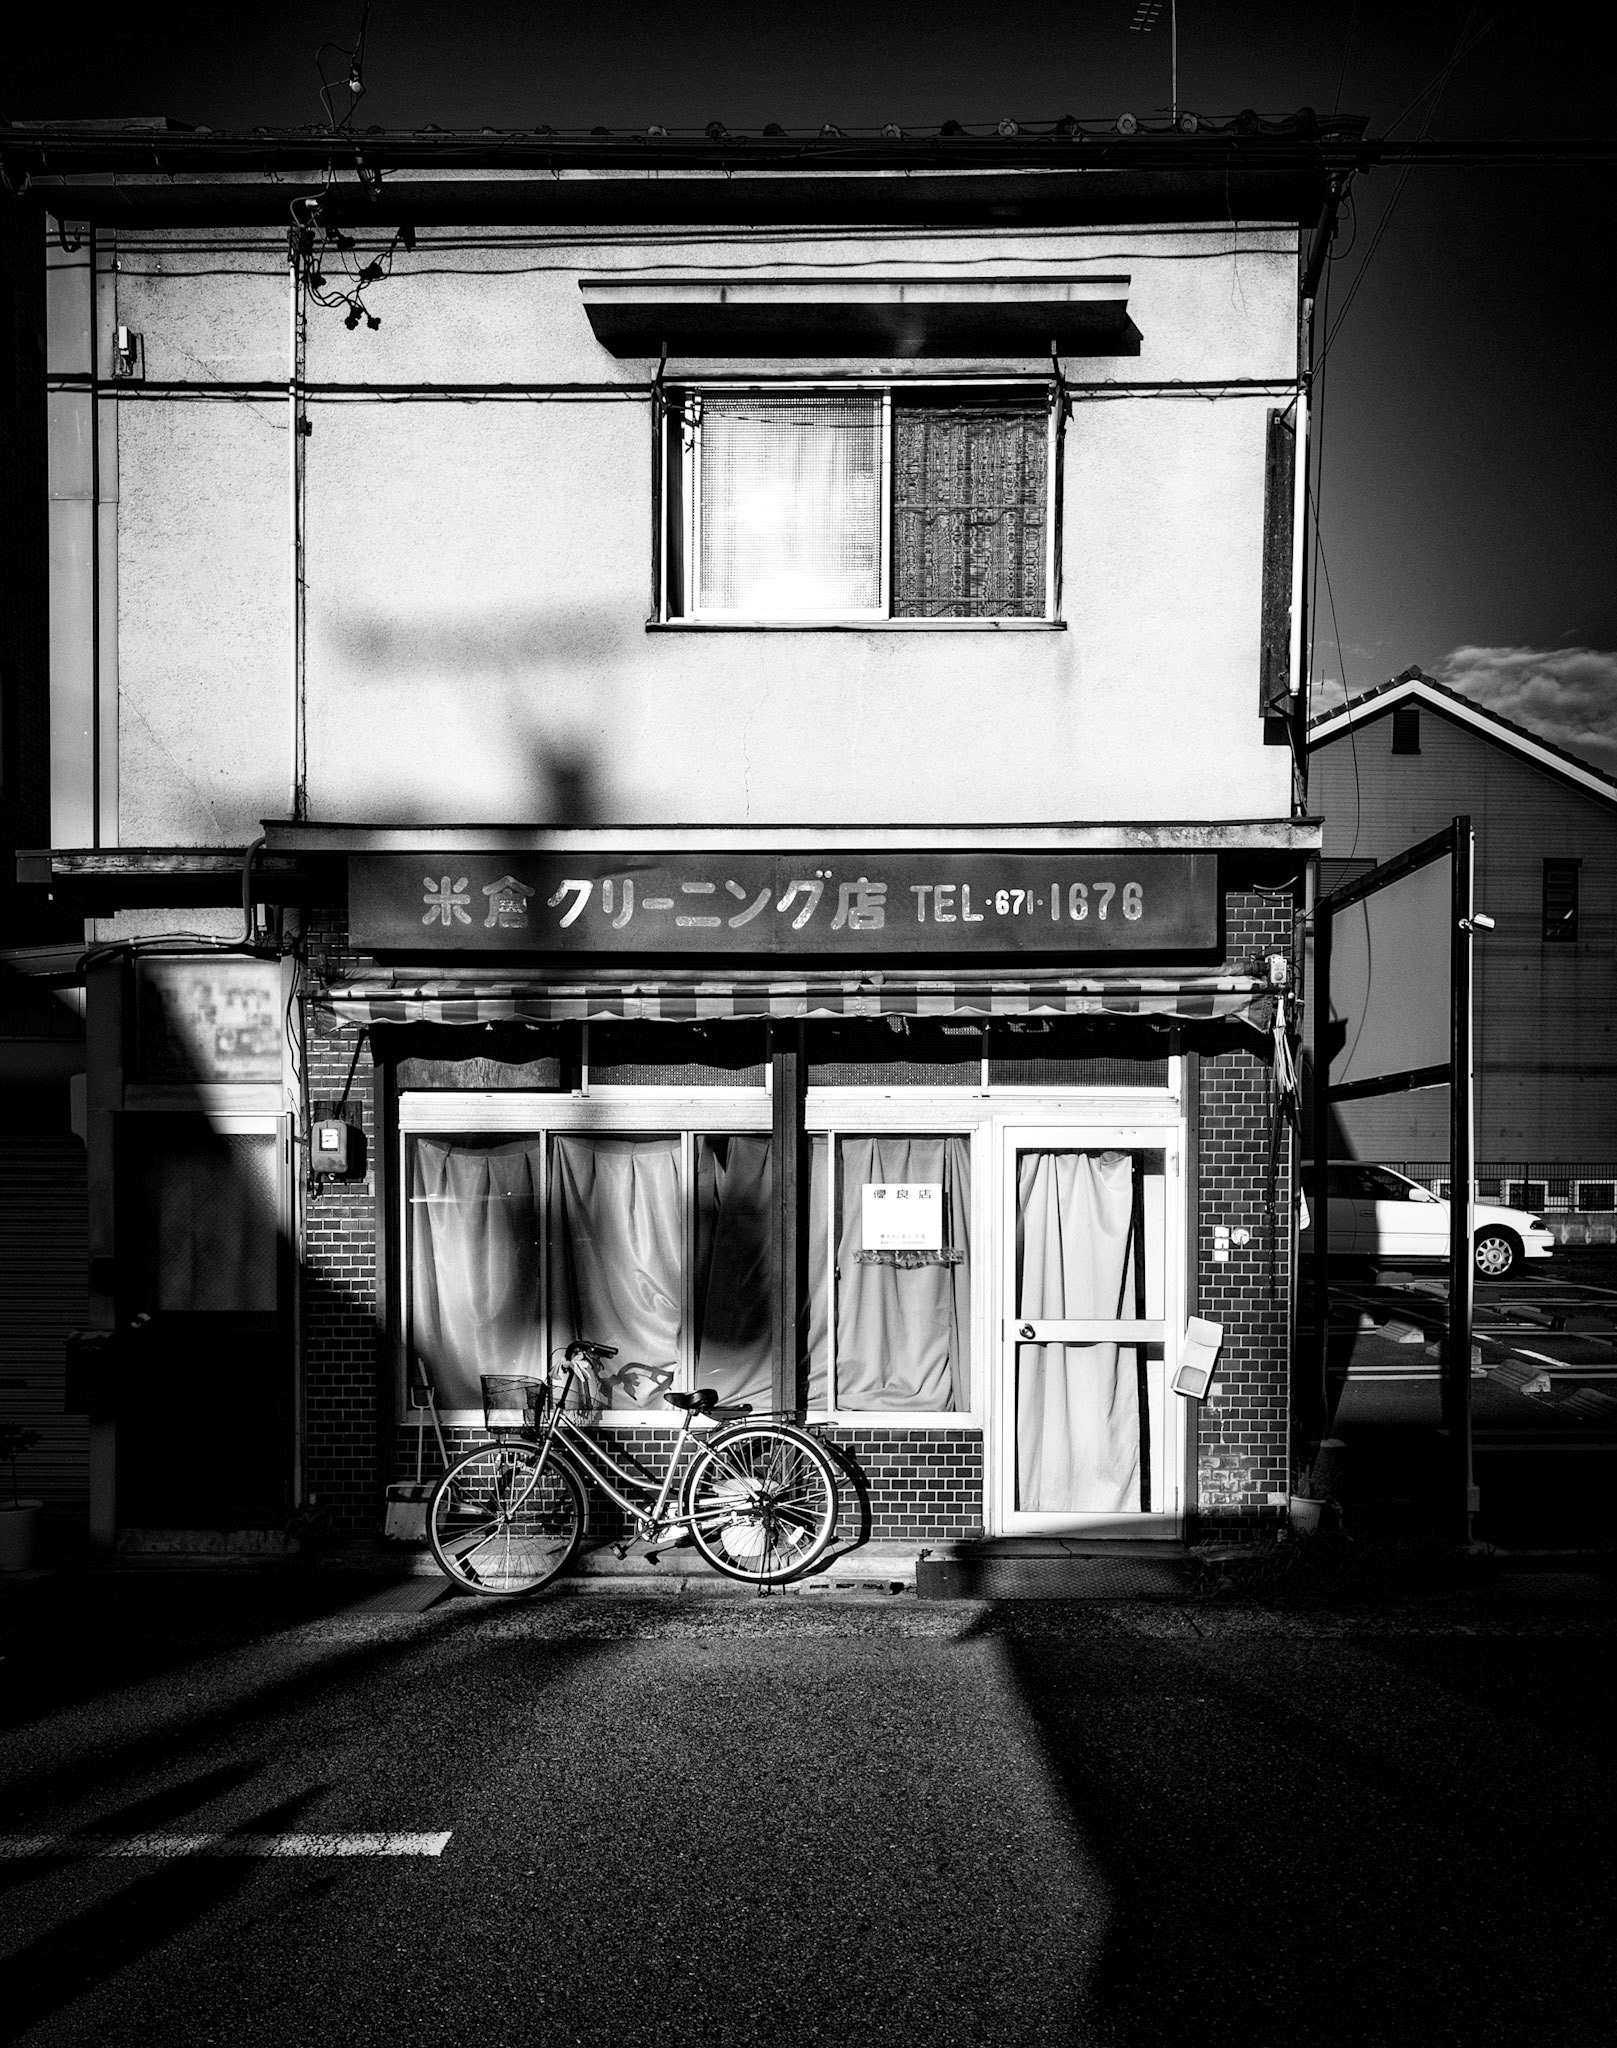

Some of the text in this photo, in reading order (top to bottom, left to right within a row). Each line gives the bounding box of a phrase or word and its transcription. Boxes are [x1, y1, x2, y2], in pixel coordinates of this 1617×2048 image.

[422, 870, 888, 930] 米倉クリーニング店
